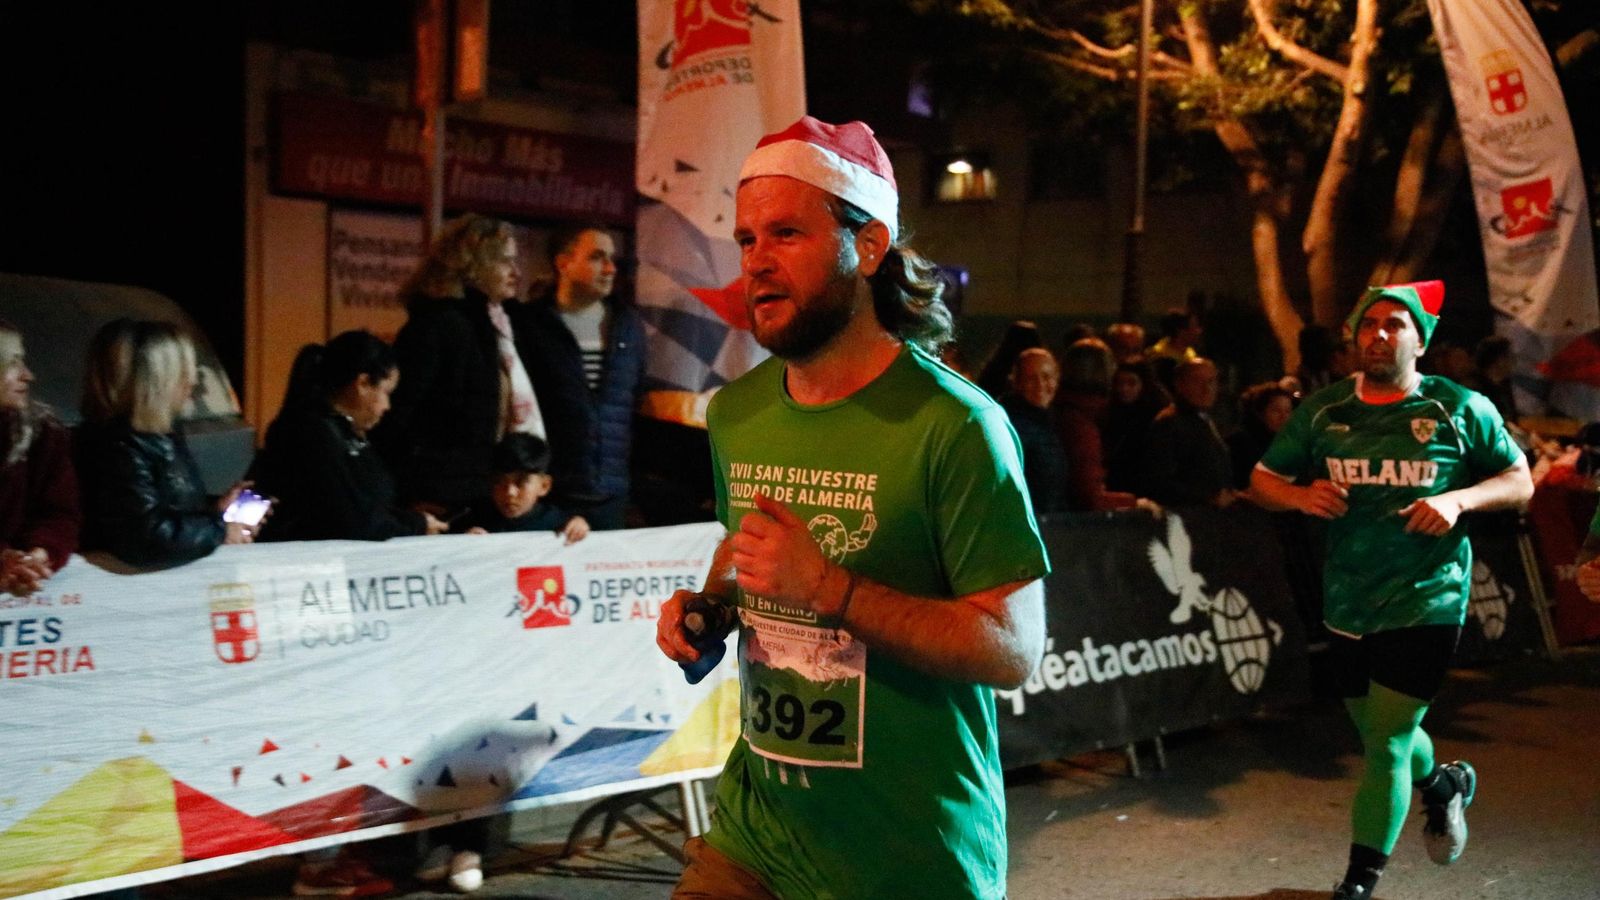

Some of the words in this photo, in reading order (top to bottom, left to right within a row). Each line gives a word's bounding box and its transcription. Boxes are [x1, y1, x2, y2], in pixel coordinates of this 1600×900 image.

[730, 463, 752, 479] XVII
[754, 465, 784, 481] SAN
[787, 467, 878, 491] SILVESTRE
[1326, 457, 1438, 487] RELAND
[774, 486, 794, 503] DE
[797, 489, 874, 511] ALMERÍA
[298, 565, 466, 616] ALMERÍA
[589, 575, 697, 600] DEPORTES
[593, 602, 621, 624] DE
